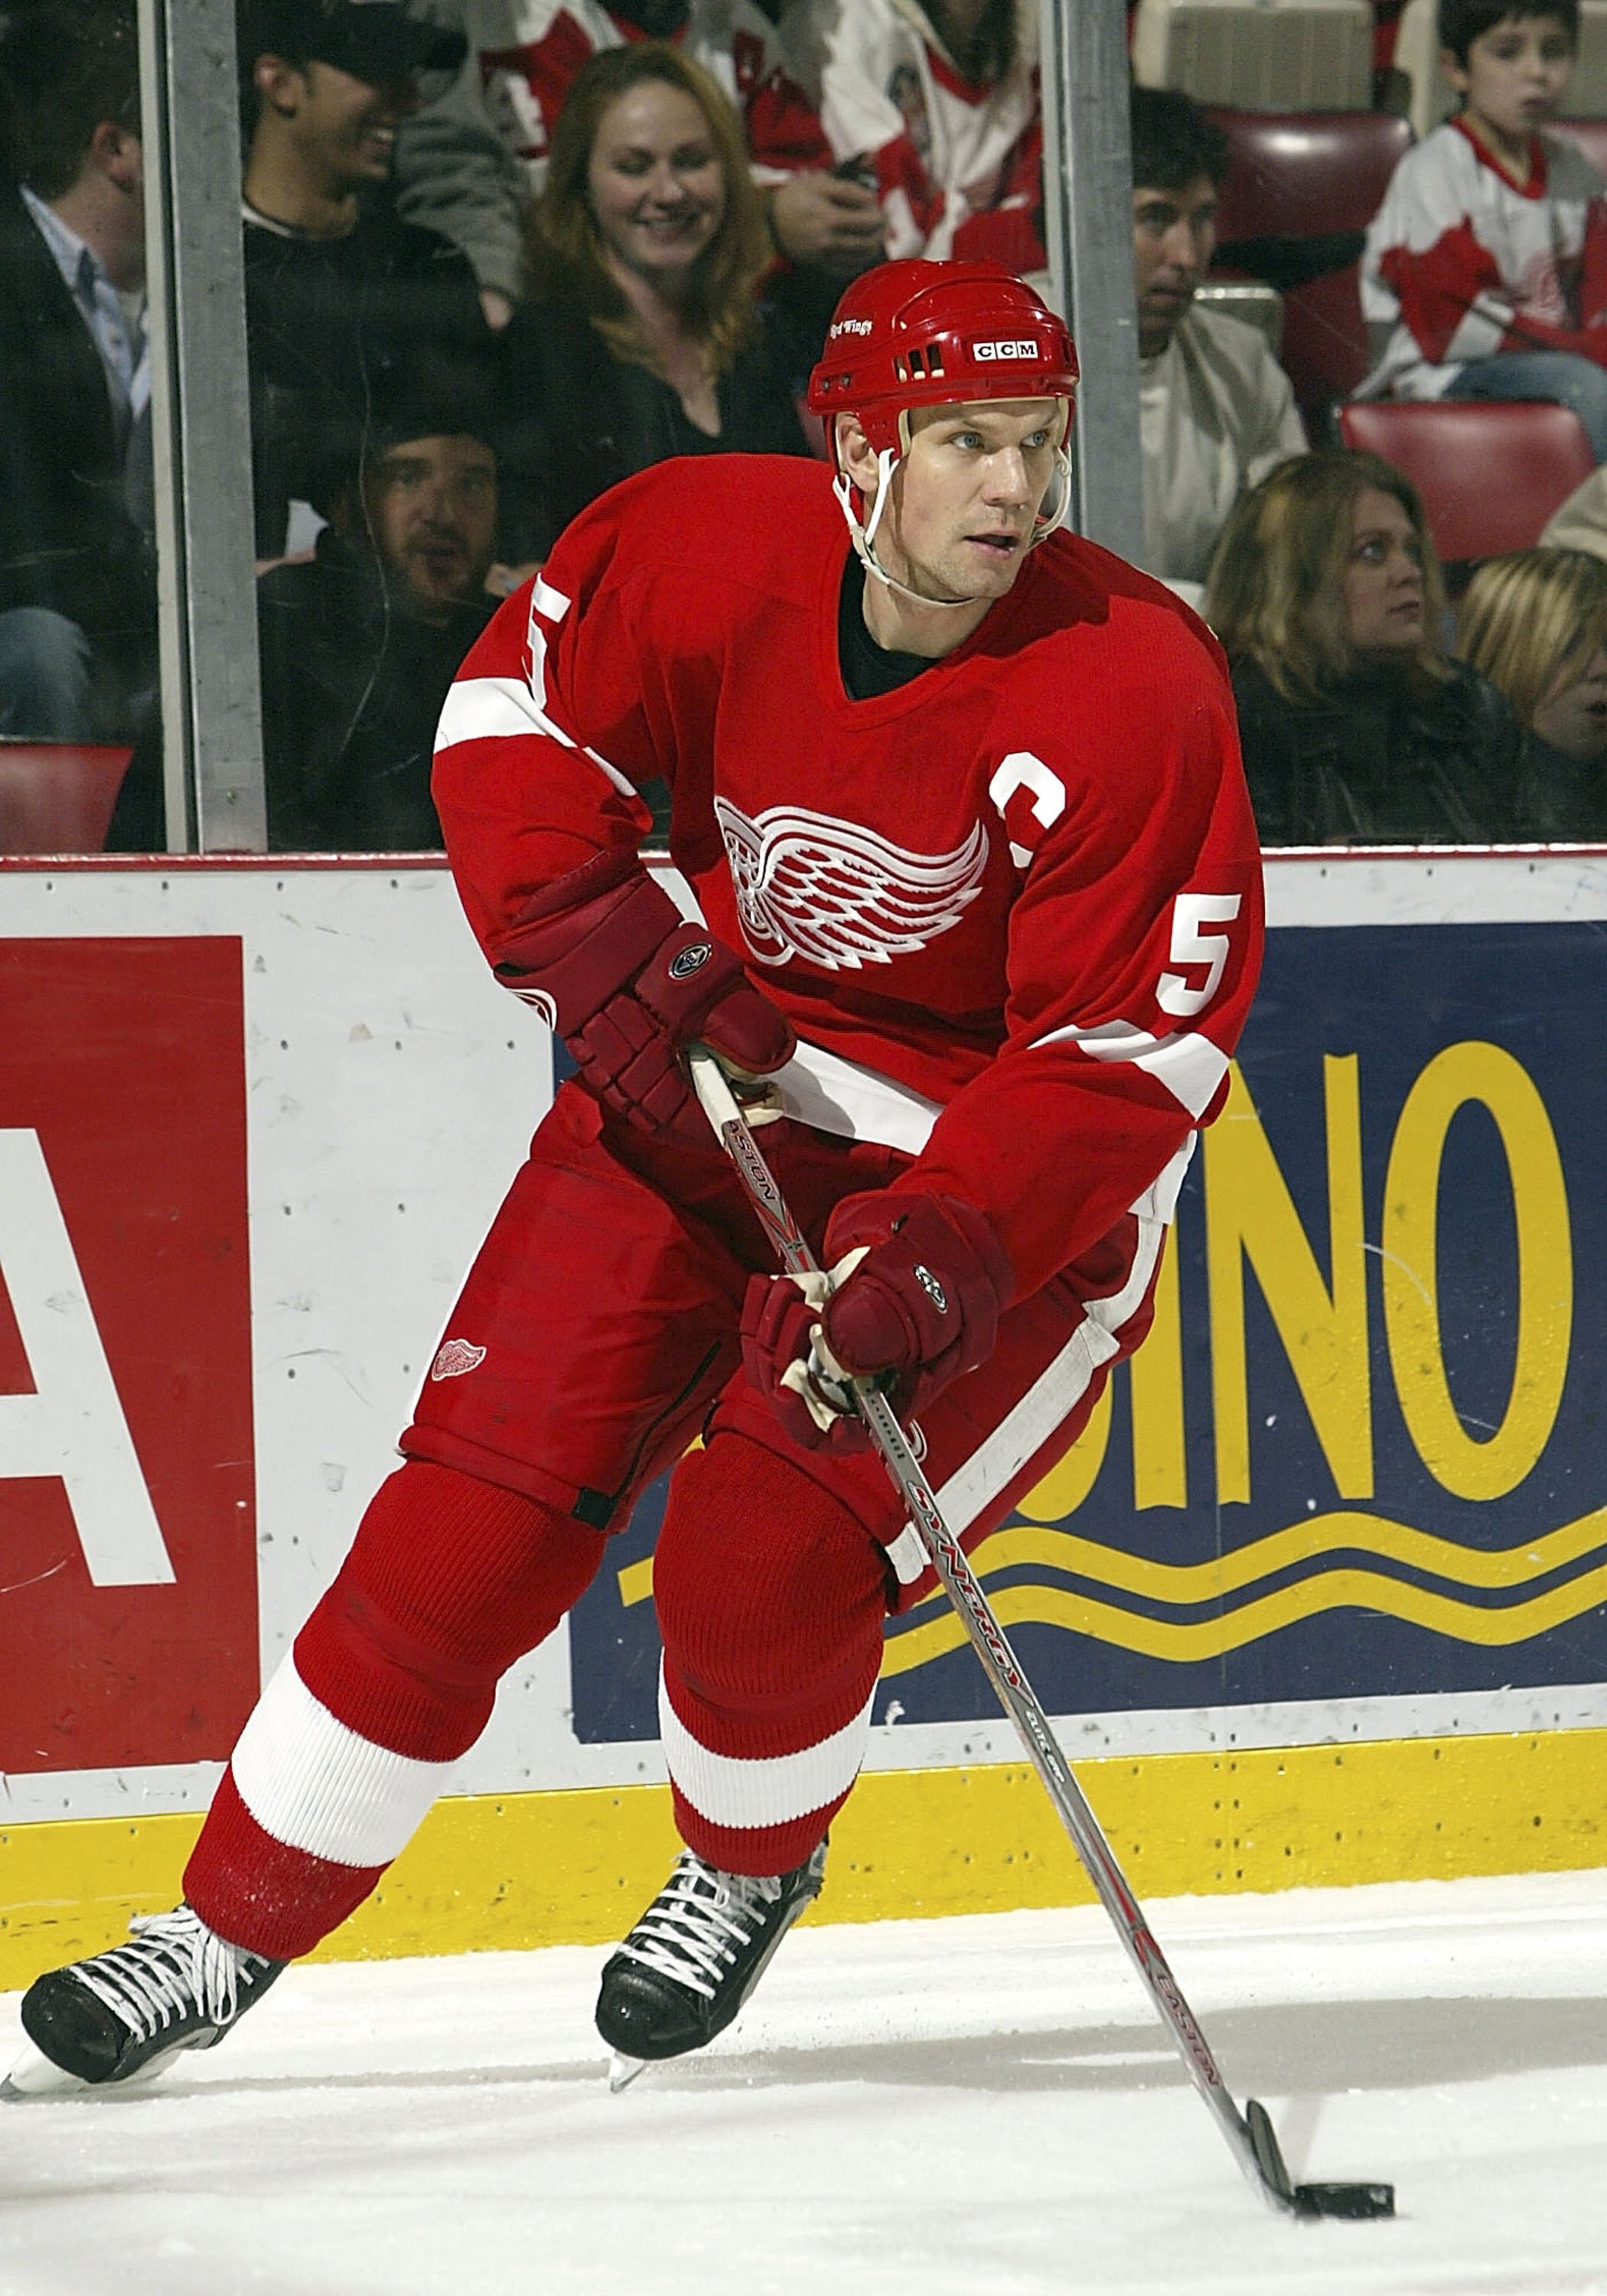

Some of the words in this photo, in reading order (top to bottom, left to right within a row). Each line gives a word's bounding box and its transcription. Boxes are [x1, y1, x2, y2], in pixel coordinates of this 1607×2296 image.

[976, 343, 1036, 359] CCM
[989, 751, 1066, 869] C
[1156, 893, 1242, 1016] 5
[727, 1120, 776, 1201] ASTON
[1014, 1039, 1573, 1523] INO
[908, 1480, 1035, 1707] SYNERGY
[1156, 1974, 1220, 2086] EASTON
